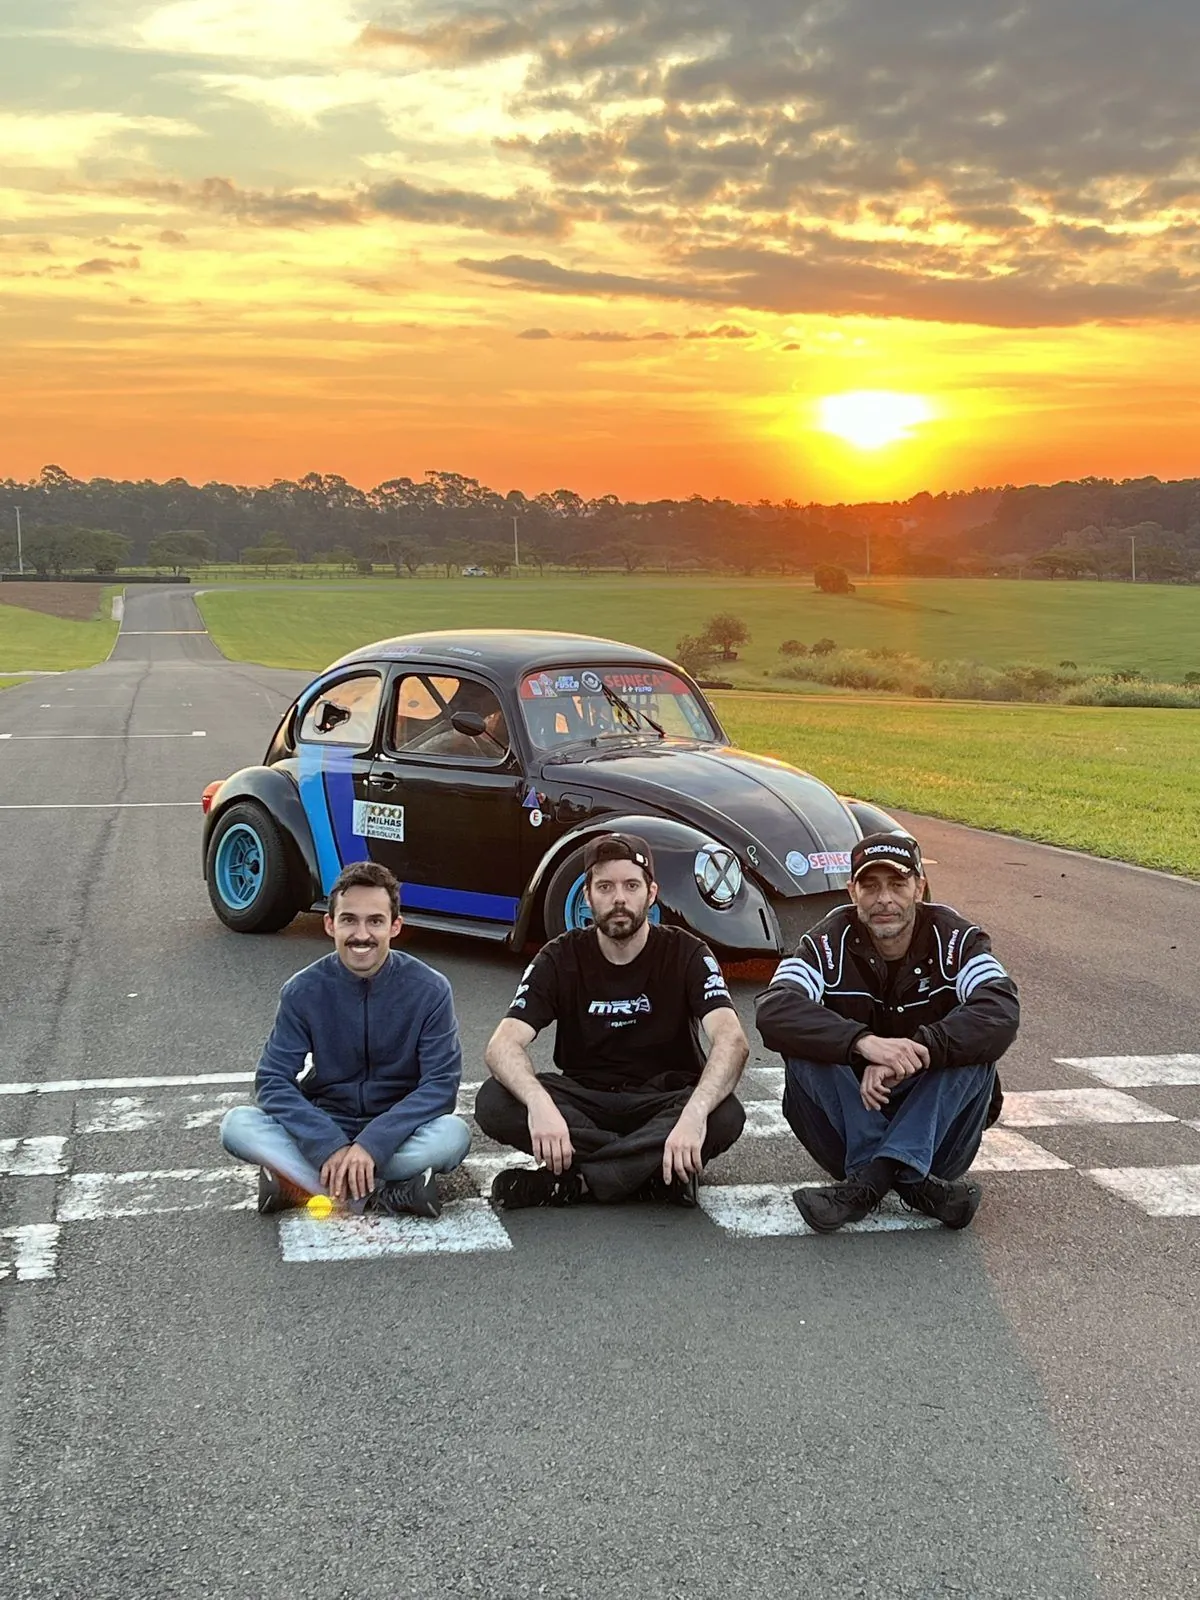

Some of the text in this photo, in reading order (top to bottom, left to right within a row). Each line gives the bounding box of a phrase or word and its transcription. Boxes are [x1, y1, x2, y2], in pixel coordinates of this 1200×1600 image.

[555, 680, 580, 689] FUSCA
[367, 816, 402, 827] MILHAS
[533, 812, 540, 821] E
[367, 829, 401, 839] ABSOLUTA
[863, 845, 911, 858] YOKOHAMA
[809, 853, 851, 867] SEINEC
